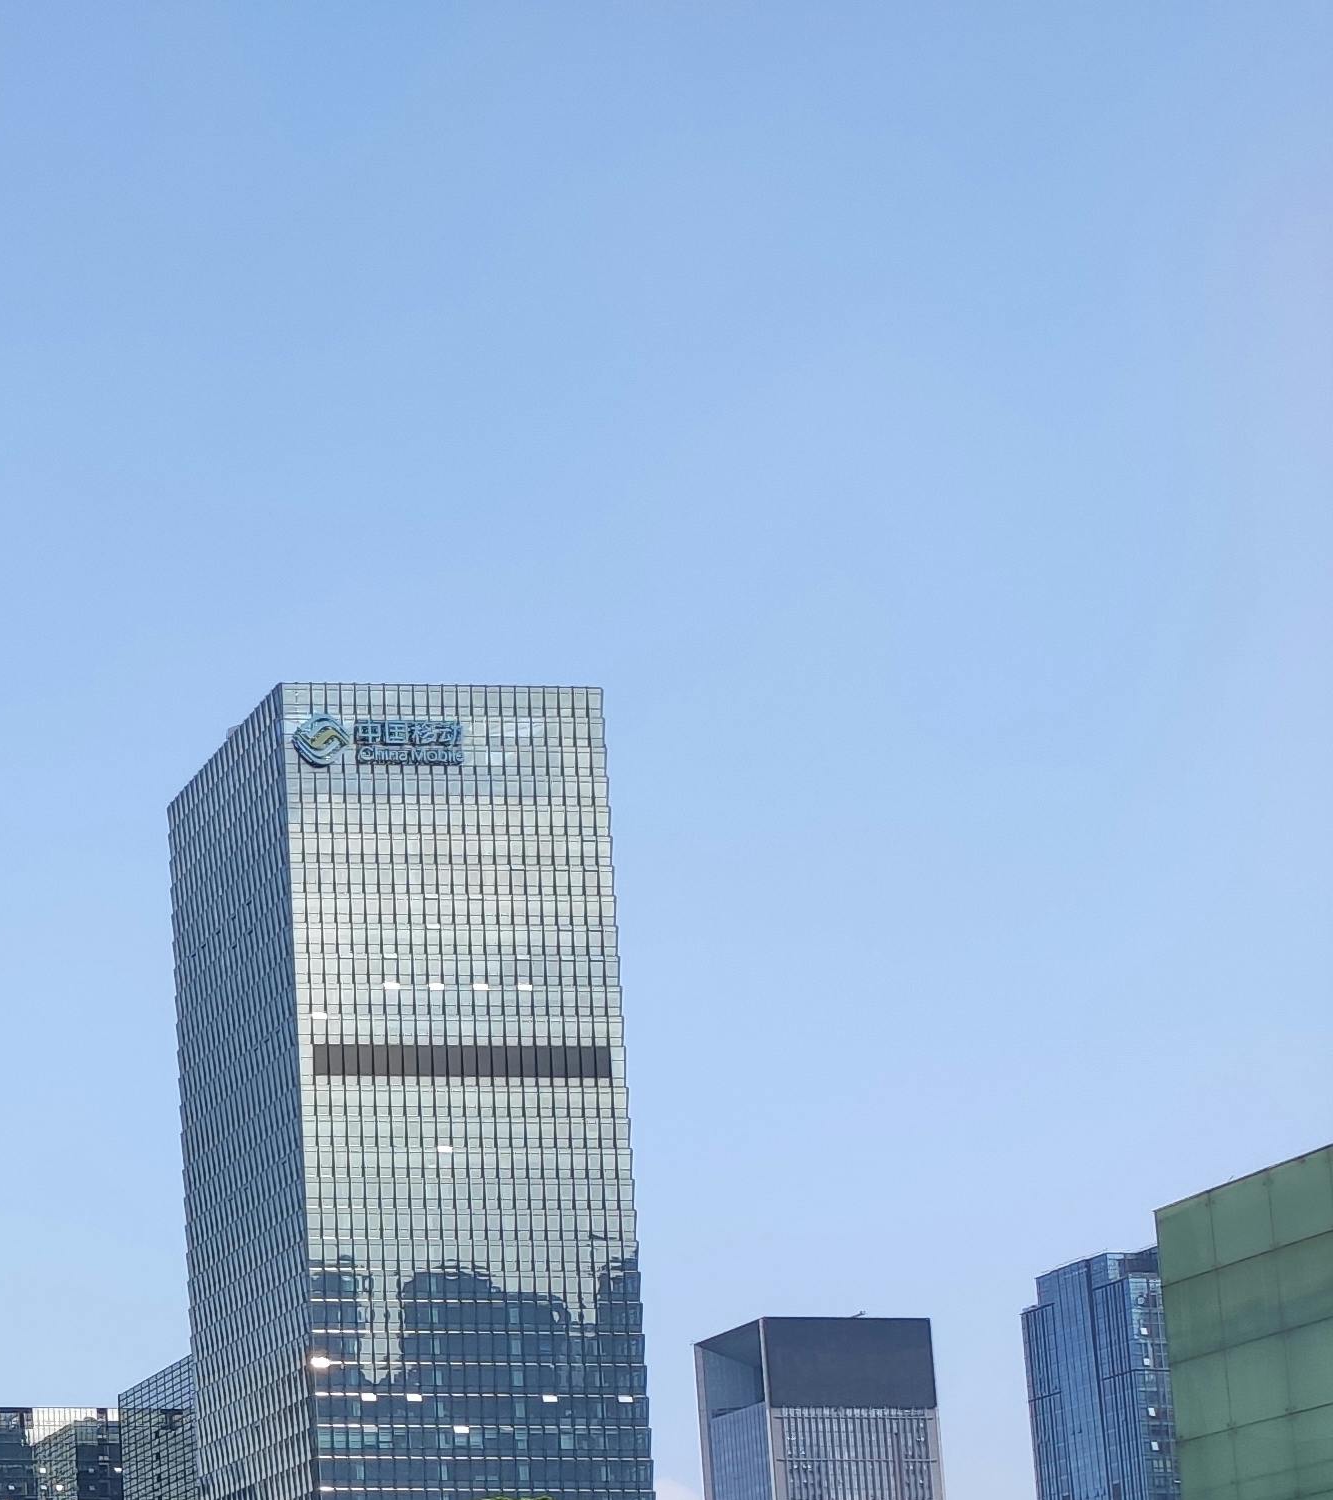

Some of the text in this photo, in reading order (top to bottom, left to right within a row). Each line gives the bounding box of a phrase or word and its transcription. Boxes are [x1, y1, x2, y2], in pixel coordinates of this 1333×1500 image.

[357, 720, 463, 744] 中国移动
[359, 746, 464, 762] China Mobile
